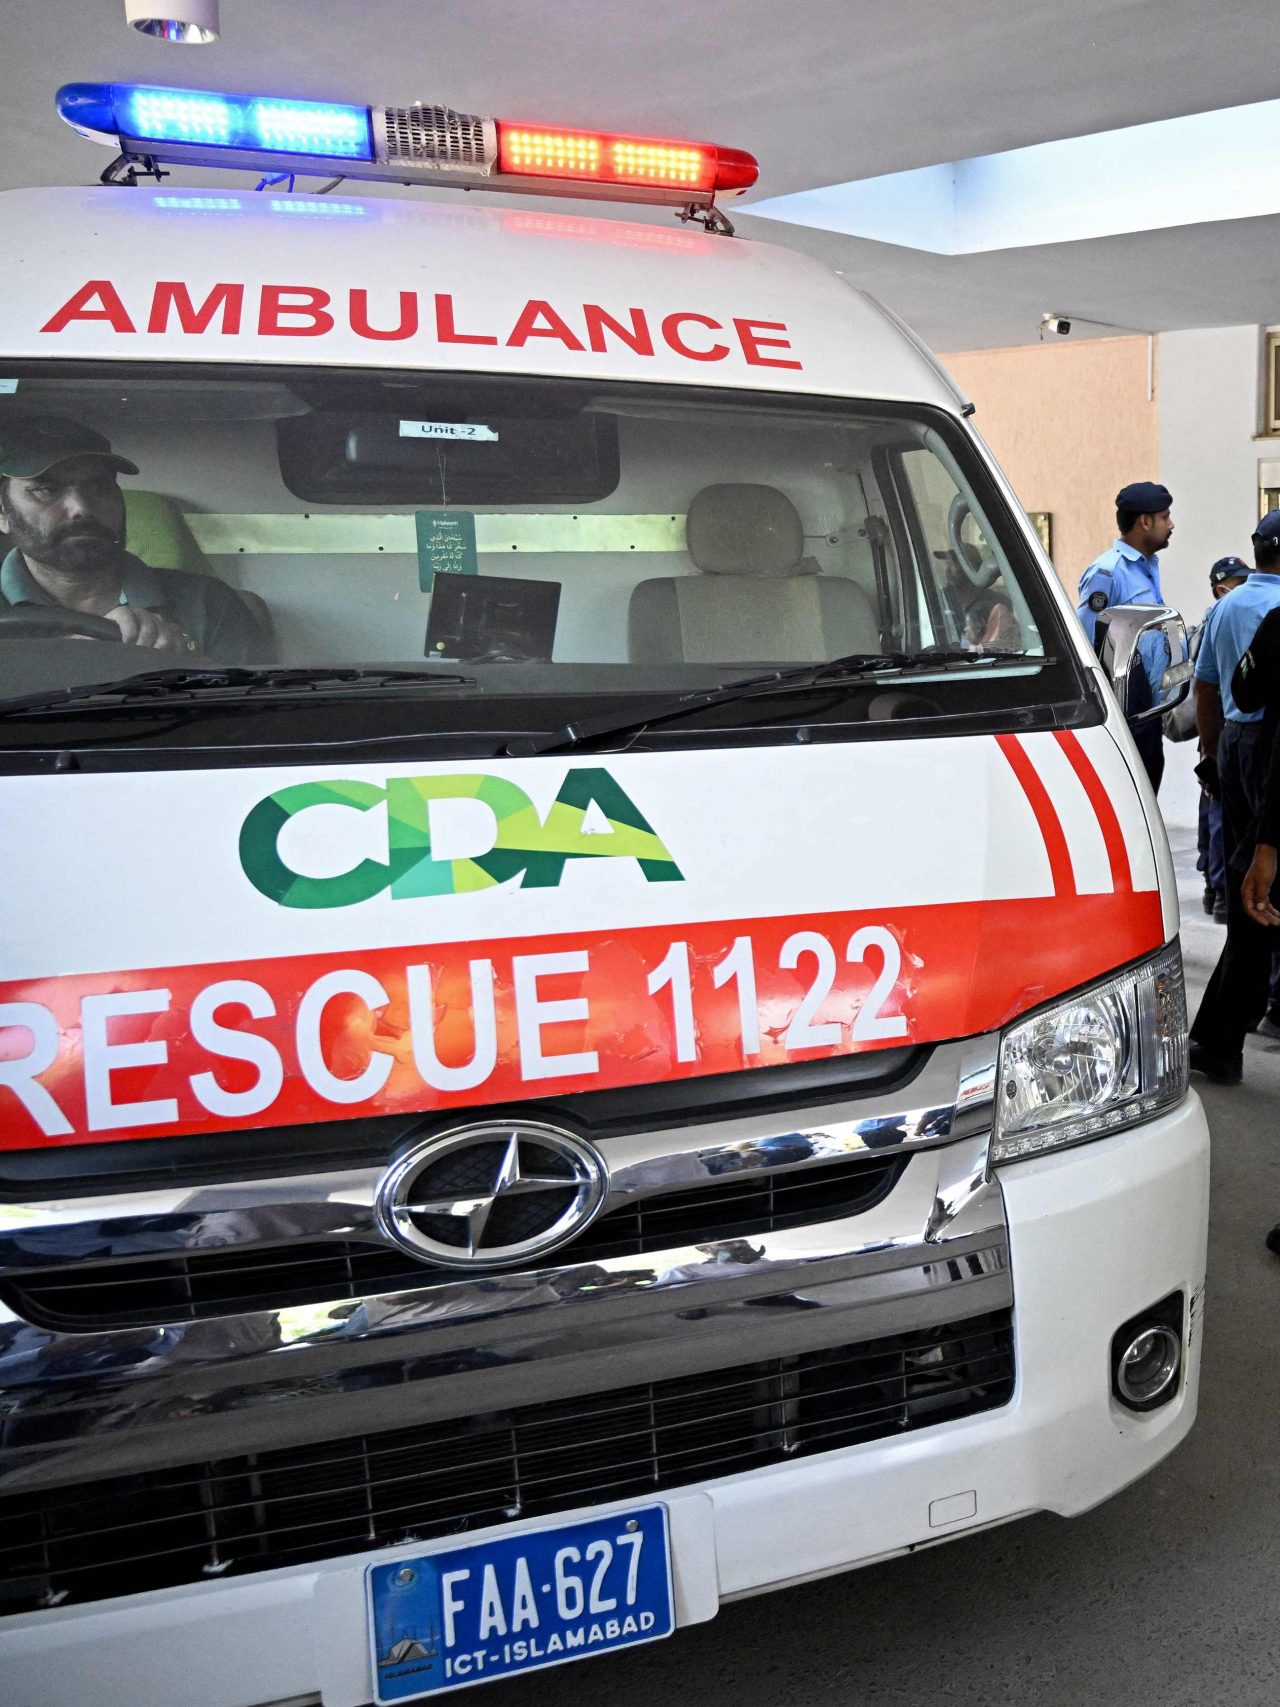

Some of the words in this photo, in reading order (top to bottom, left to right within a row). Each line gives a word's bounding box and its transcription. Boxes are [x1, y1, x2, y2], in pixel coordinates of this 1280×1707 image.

[40, 280, 803, 370] AMBULANCE
[421, 425, 456, 435] Unit
[238, 768, 685, 909] CDA
[0, 949, 599, 1137] RESCUE
[646, 925, 908, 1064] 1122
[445, 1610, 656, 1678] ICT-ISLAMABAD
